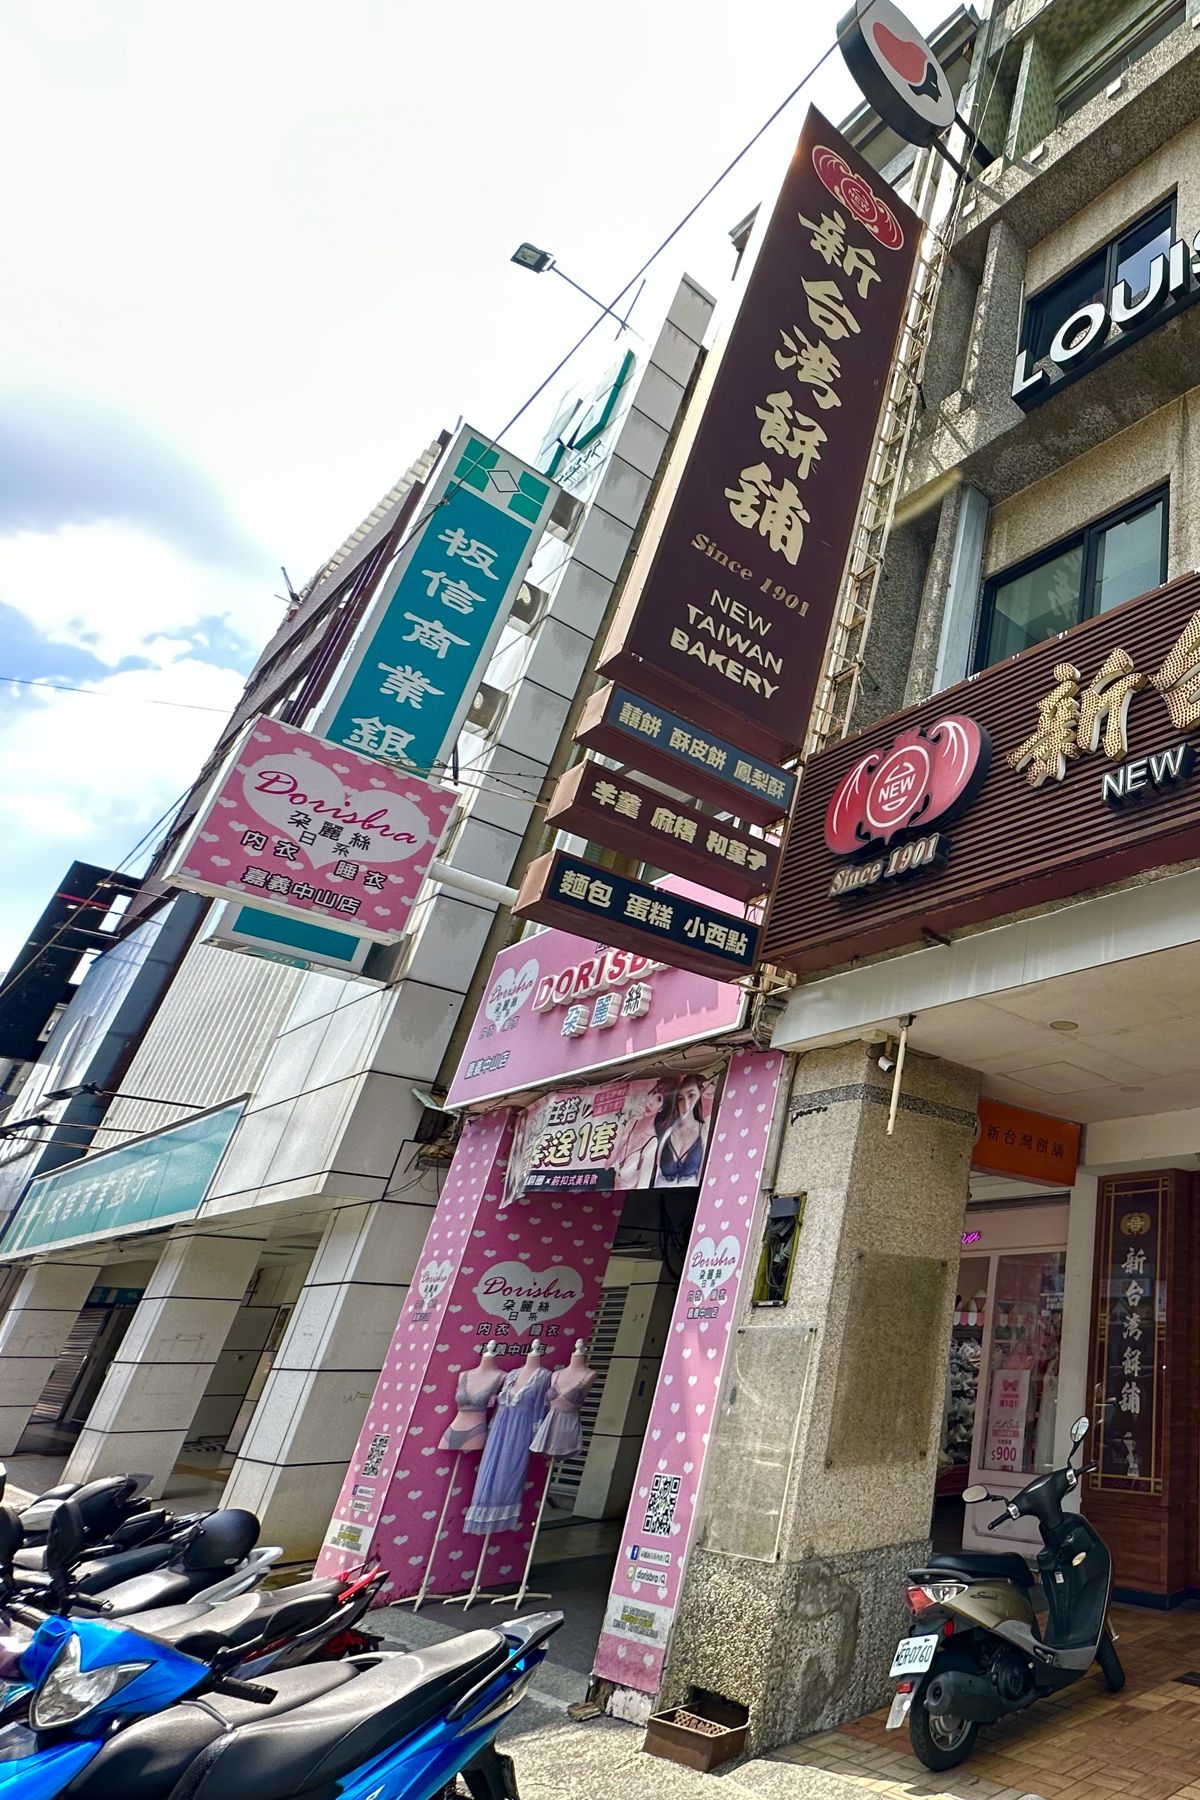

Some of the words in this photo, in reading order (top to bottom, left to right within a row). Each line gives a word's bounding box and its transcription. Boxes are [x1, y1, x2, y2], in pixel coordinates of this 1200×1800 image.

[691, 533, 753, 581] Since
[759, 577, 810, 618] 1901
[687, 603, 784, 675] TAIWAN
[710, 588, 772, 637] NEW
[670, 626, 780, 699] BAKERY
[669, 726, 727, 771] 酥皮餅
[733, 759, 786, 801] 鳳梨酥
[878, 774, 916, 803] NEW
[1101, 744, 1192, 802] NEW
[254, 770, 418, 844] Dorisbra
[592, 780, 642, 820] 羊羹
[650, 807, 699, 845] 麻糬
[706, 830, 768, 872] 和菓子
[240, 865, 362, 916] 嘉義中山店
[828, 859, 884, 899] Since
[884, 832, 941, 878] 1901
[558, 869, 614, 909] 麵包
[623, 892, 674, 931] 蛋糕
[683, 915, 749, 957] 小西點
[532, 949, 672, 1010] DORISB
[482, 1276, 577, 1299] Dorisbra
[991, 1446, 1017, 1462] $900
